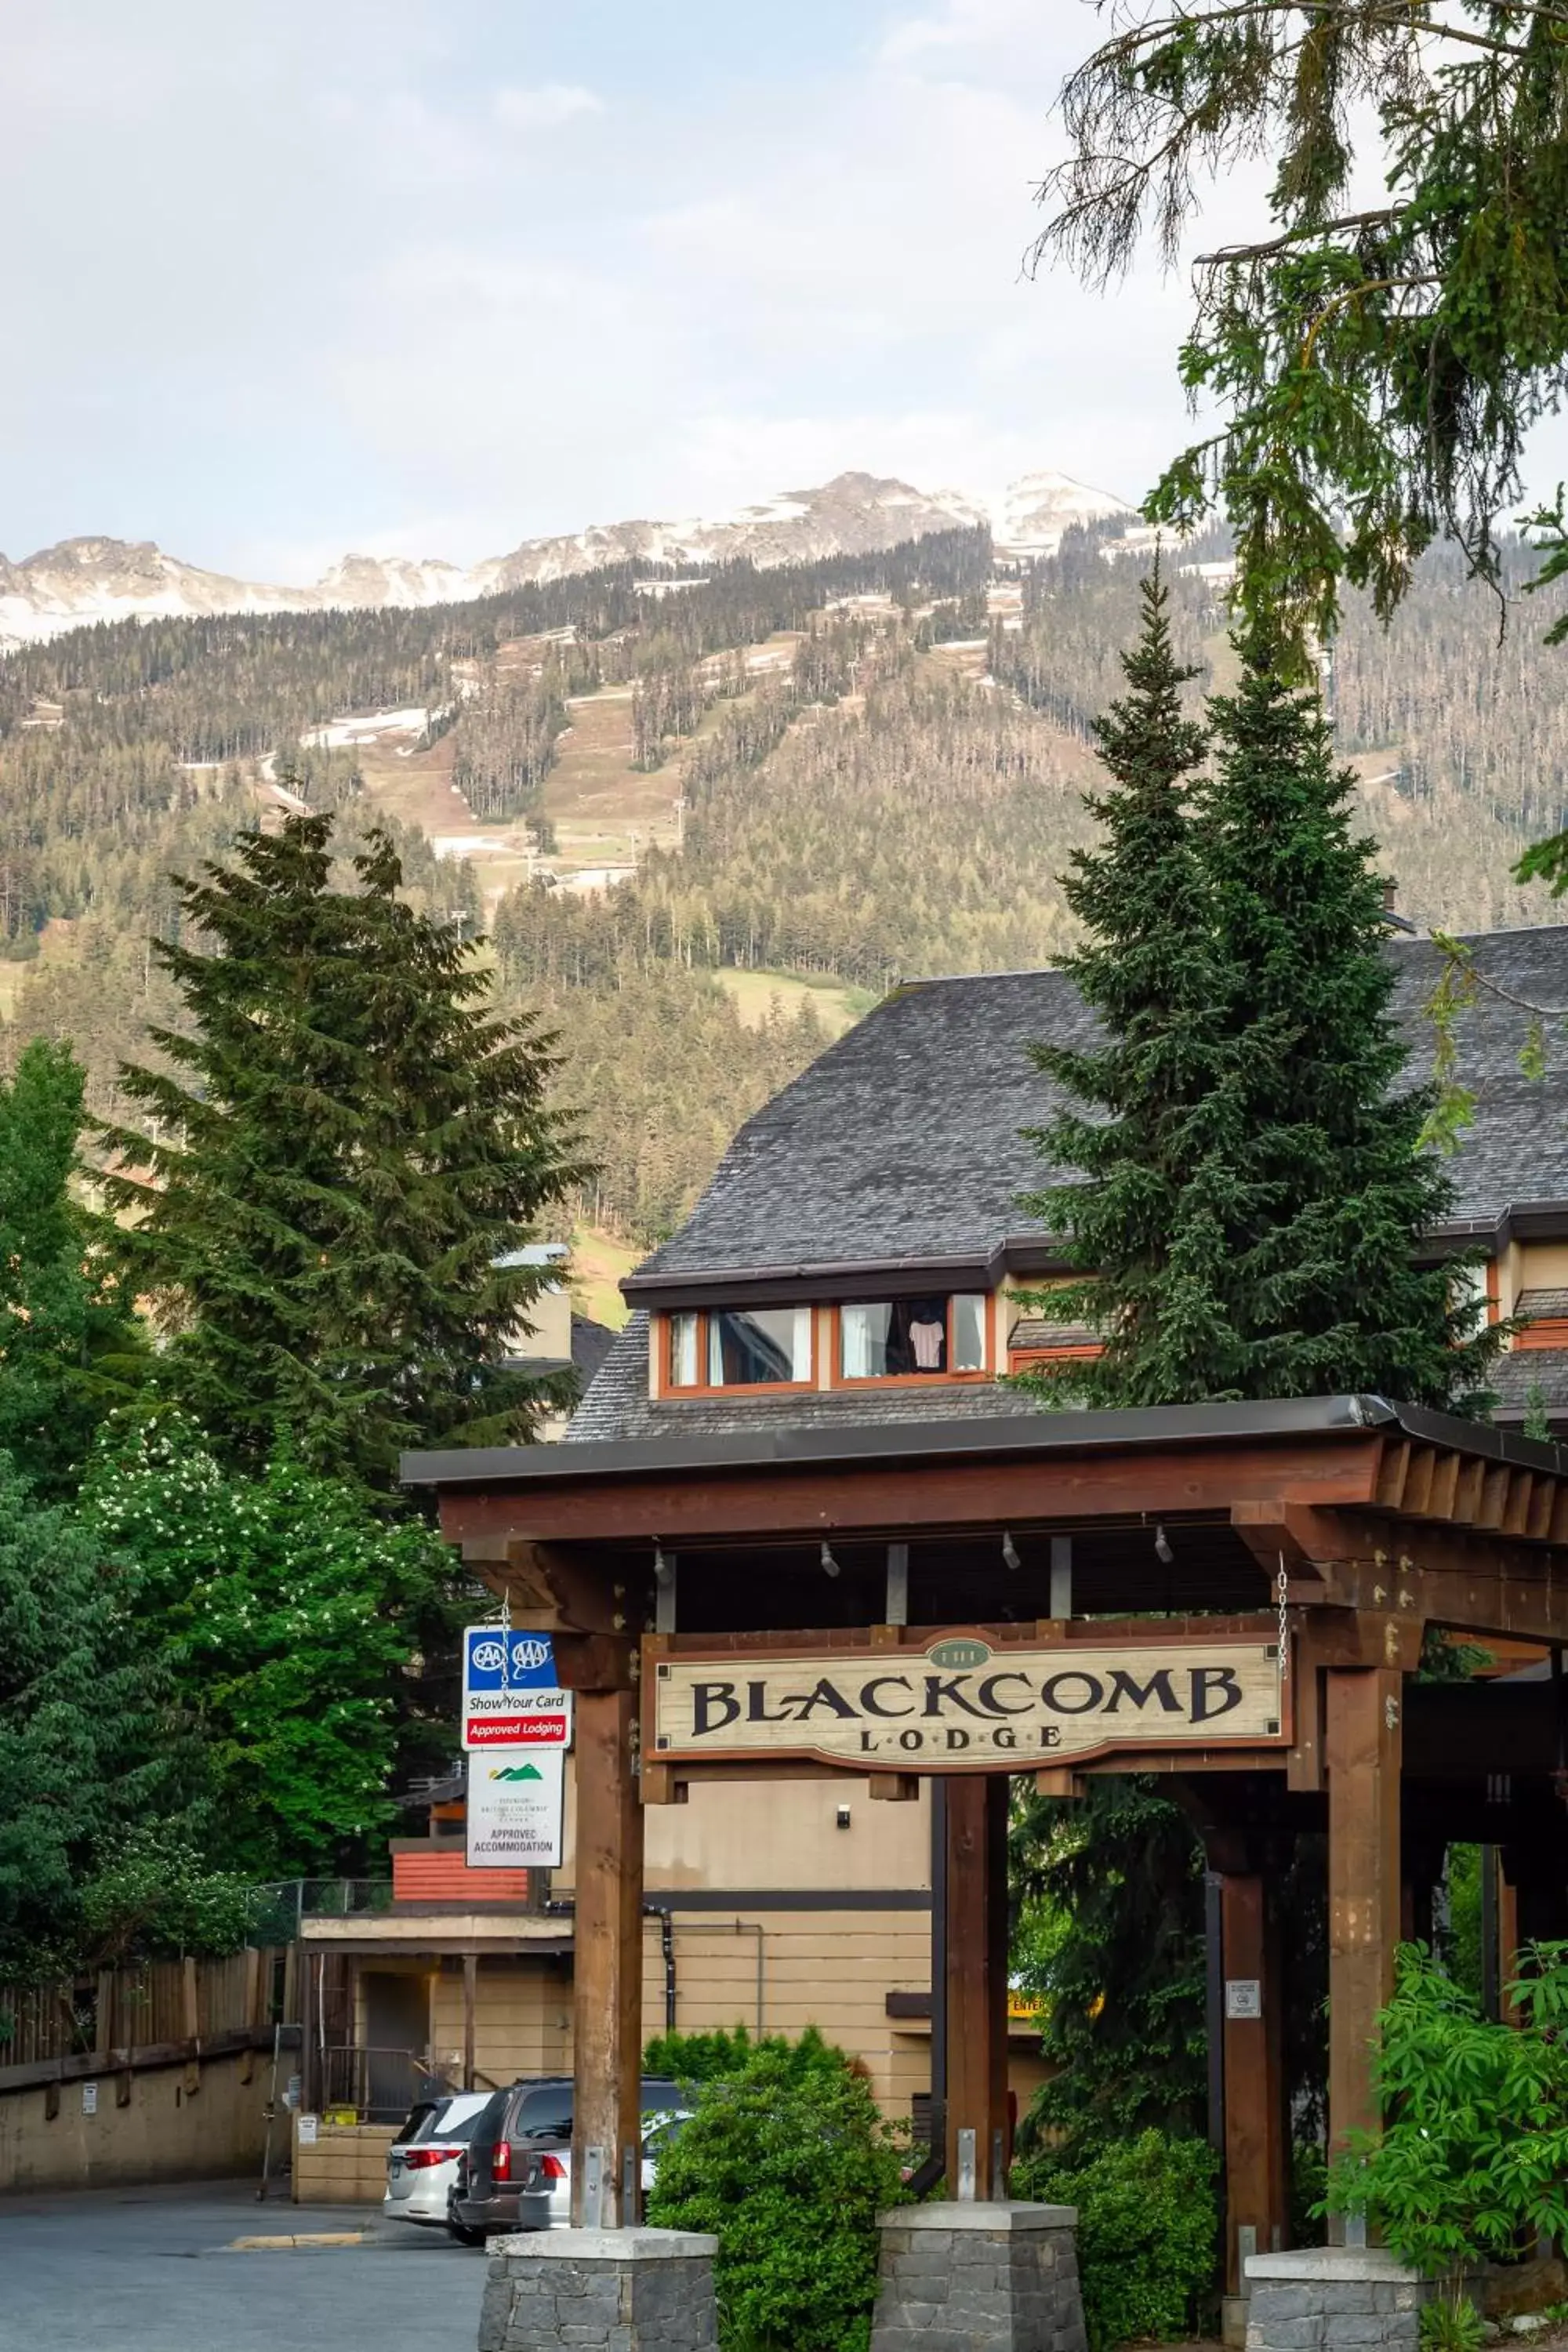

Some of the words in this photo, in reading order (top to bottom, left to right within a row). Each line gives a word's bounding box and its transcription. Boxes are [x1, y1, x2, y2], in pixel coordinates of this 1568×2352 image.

[476, 1646, 503, 1667] CAA
[515, 1641, 546, 1668] AAA
[470, 1696, 502, 1710] Show
[505, 1696, 533, 1708] Your
[535, 1693, 565, 1708] Card
[691, 1667, 1243, 1736] BLACKCOMB
[470, 1723, 521, 1737] Approved
[522, 1722, 563, 1737] Lodging
[474, 1841, 553, 1853] ACCOMMODATION
